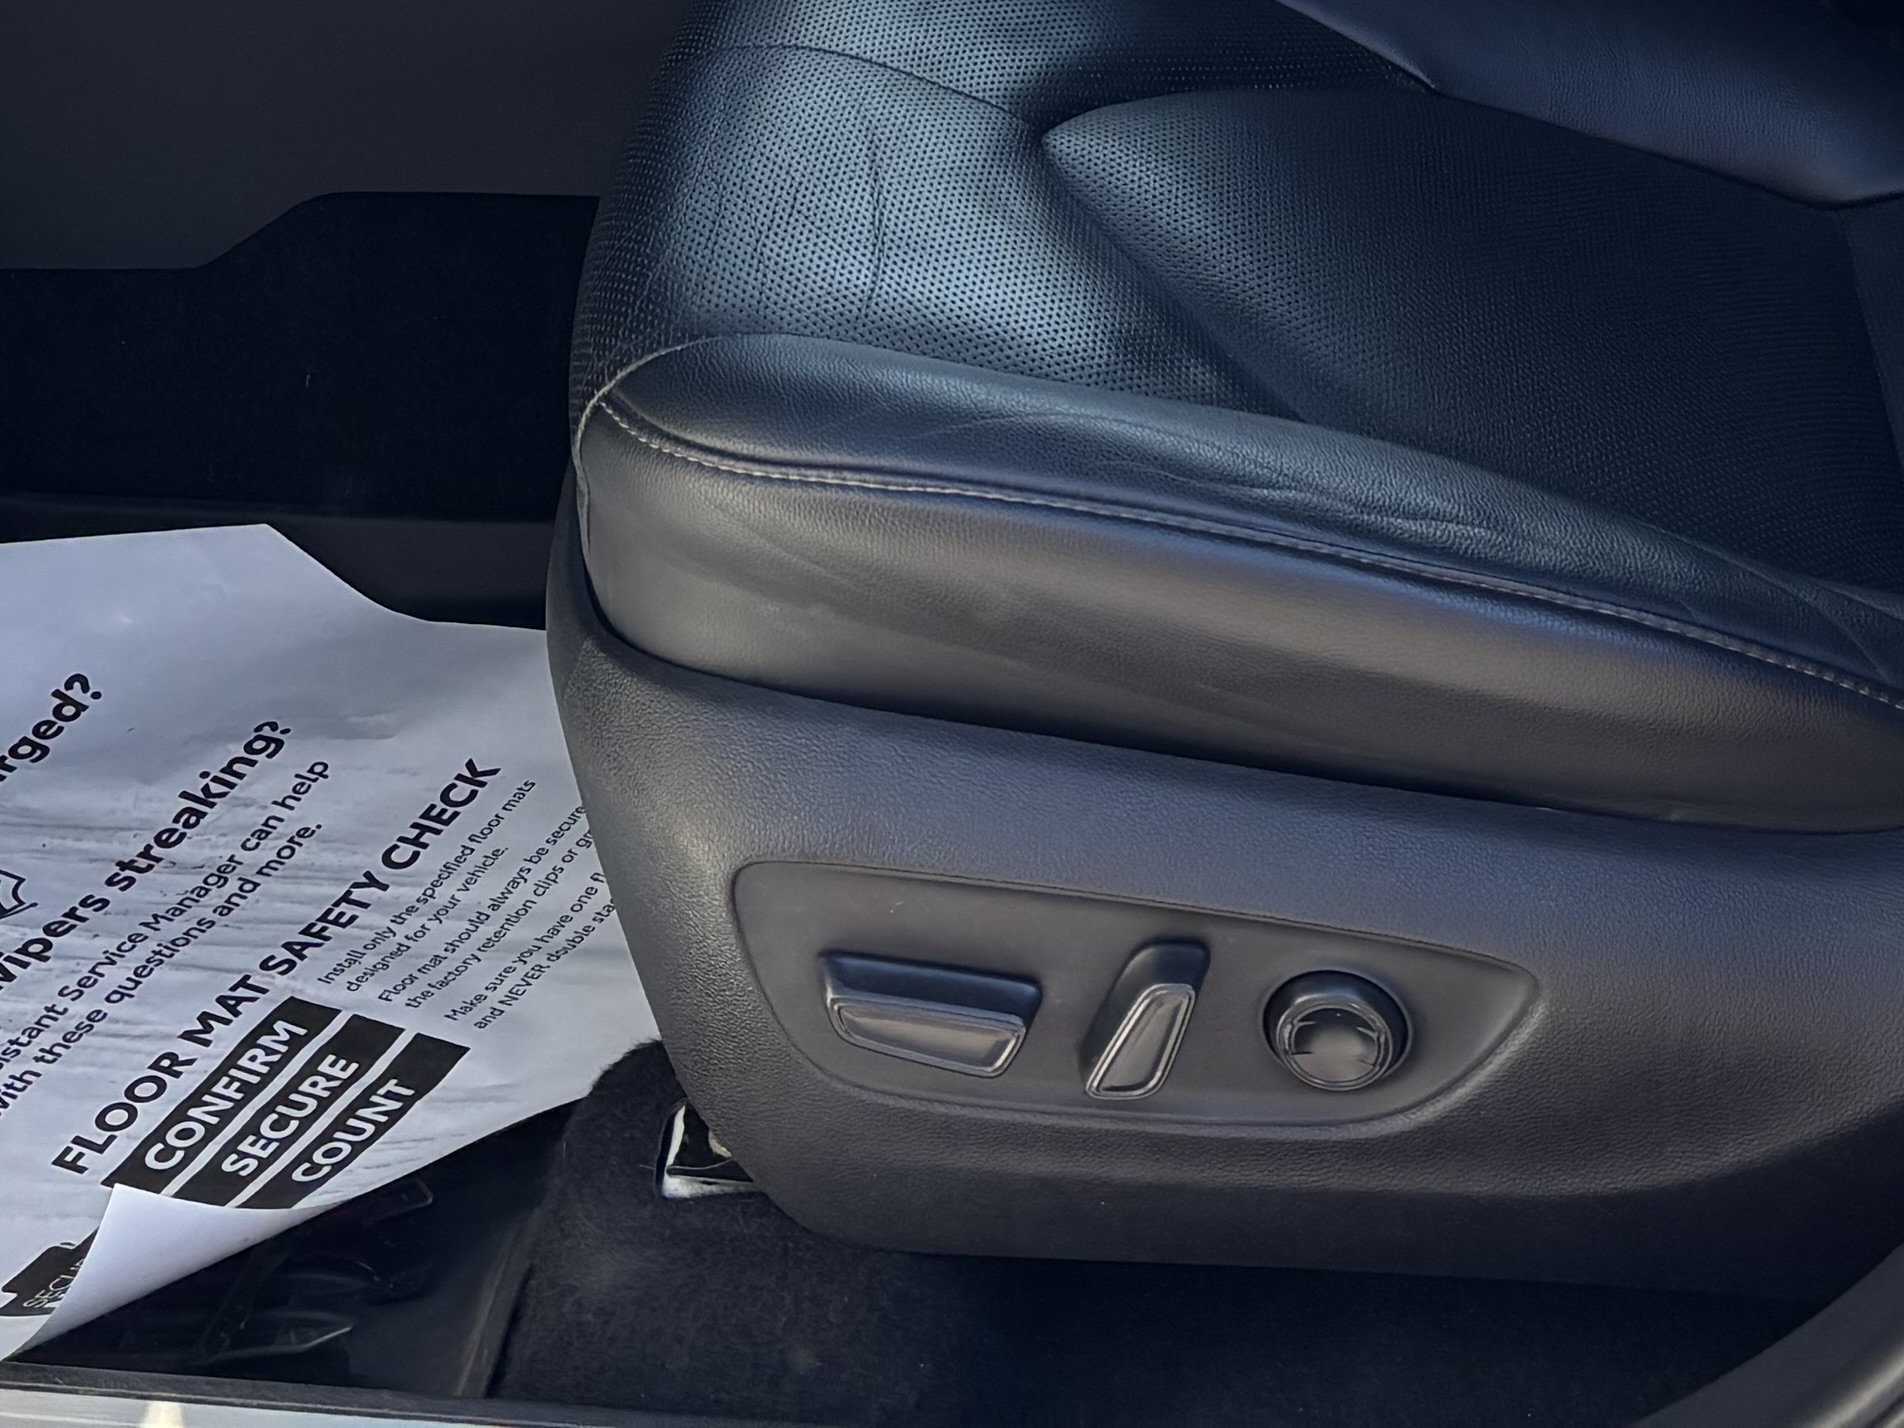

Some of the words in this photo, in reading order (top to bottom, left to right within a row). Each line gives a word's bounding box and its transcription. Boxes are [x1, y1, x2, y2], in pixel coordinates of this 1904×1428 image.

[57, 932, 149, 1002] Service
[138, 854, 244, 949] Manager
[240, 815, 285, 852] can
[271, 761, 329, 811] help
[104, 720, 292, 892] streaking?
[317, 949, 367, 985] Install
[362, 926, 397, 951] only
[389, 905, 420, 925] the
[415, 844, 476, 905] specified
[467, 813, 505, 844] floor
[501, 780, 536, 812] mats
[32, 1009, 108, 1065] these
[104, 917, 217, 1004] questions
[212, 876, 261, 917] and
[255, 824, 322, 877] more.
[51, 1051, 198, 1175] FLOOR
[176, 974, 270, 1048] MAT
[259, 870, 390, 976] SAFETY
[381, 758, 501, 870] CHECK
[346, 942, 412, 992] designed
[403, 923, 431, 943] for
[427, 894, 461, 925] your
[456, 848, 505, 892] vehicle.
[377, 973, 419, 1002] Floor
[416, 954, 448, 975] mat
[443, 910, 491, 954] should
[487, 866, 532, 912] always
[523, 847, 550, 865] be
[404, 990, 435, 1009] the
[427, 953, 482, 991] factory
[476, 899, 537, 953] retention
[533, 865, 565, 897] clips
[561, 848, 579, 864] or
[443, 993, 488, 1021] Make
[484, 965, 517, 993] sure
[511, 944, 543, 965] you
[533, 914, 574, 944] have
[569, 886, 598, 913] one
[473, 1006, 505, 1029] and
[497, 963, 551, 1007] NEVER
[546, 916, 598, 962] double
[144, 1020, 308, 1170] CONFIRM
[221, 1054, 359, 1177] SECURE
[291, 1079, 415, 1182] COUNT
